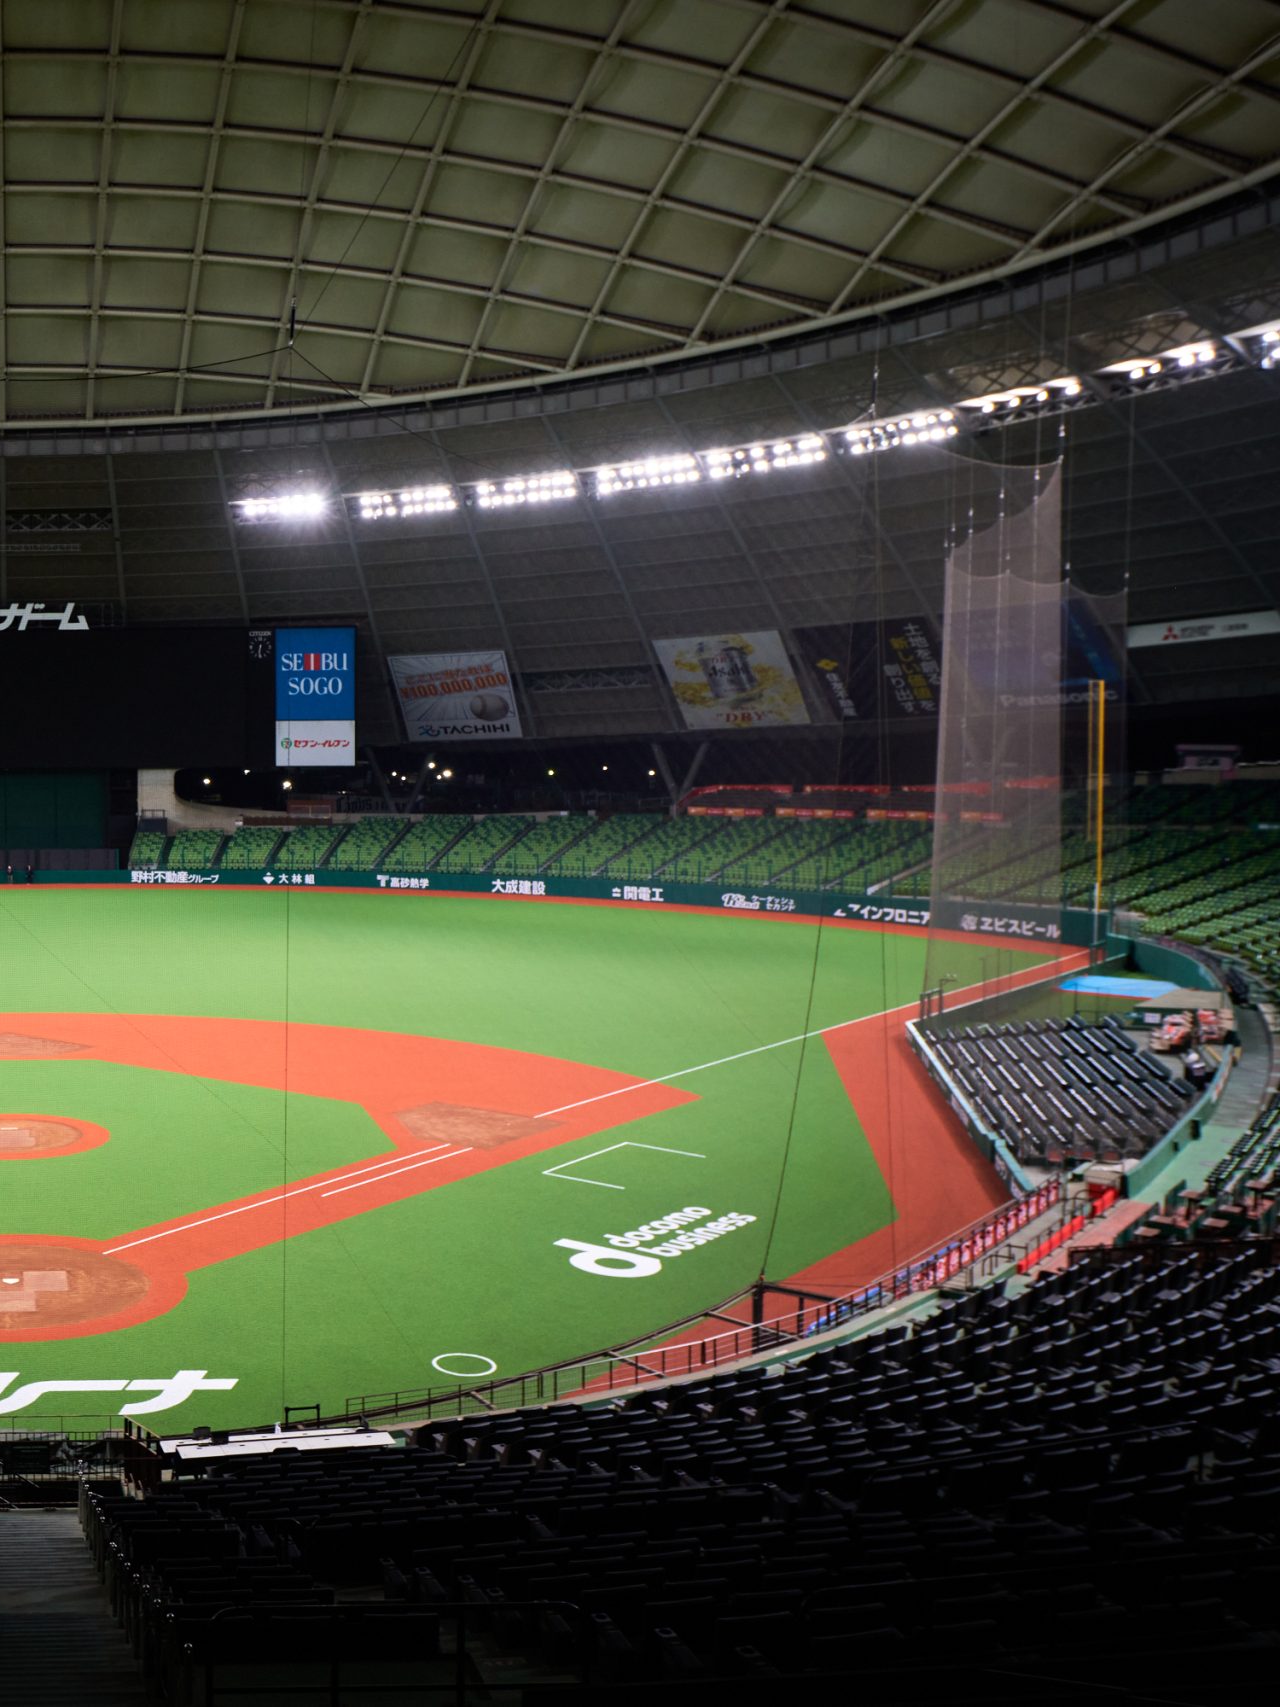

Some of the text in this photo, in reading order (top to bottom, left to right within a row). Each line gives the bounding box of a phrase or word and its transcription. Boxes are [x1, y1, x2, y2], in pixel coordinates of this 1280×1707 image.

[281, 652, 348, 671] SEIBU
[288, 677, 343, 695] SOGO
[440, 723, 510, 735] TACHIHI
[131, 871, 219, 883] 野村不動産グループ
[279, 873, 315, 885] 大林組
[390, 877, 429, 889] 高砂熱学
[491, 878, 546, 896] 大成建設
[623, 886, 664, 902] 関電工
[860, 904, 931, 925] インフロニア
[603, 1206, 712, 1248] docomo
[635, 1212, 757, 1257] business
